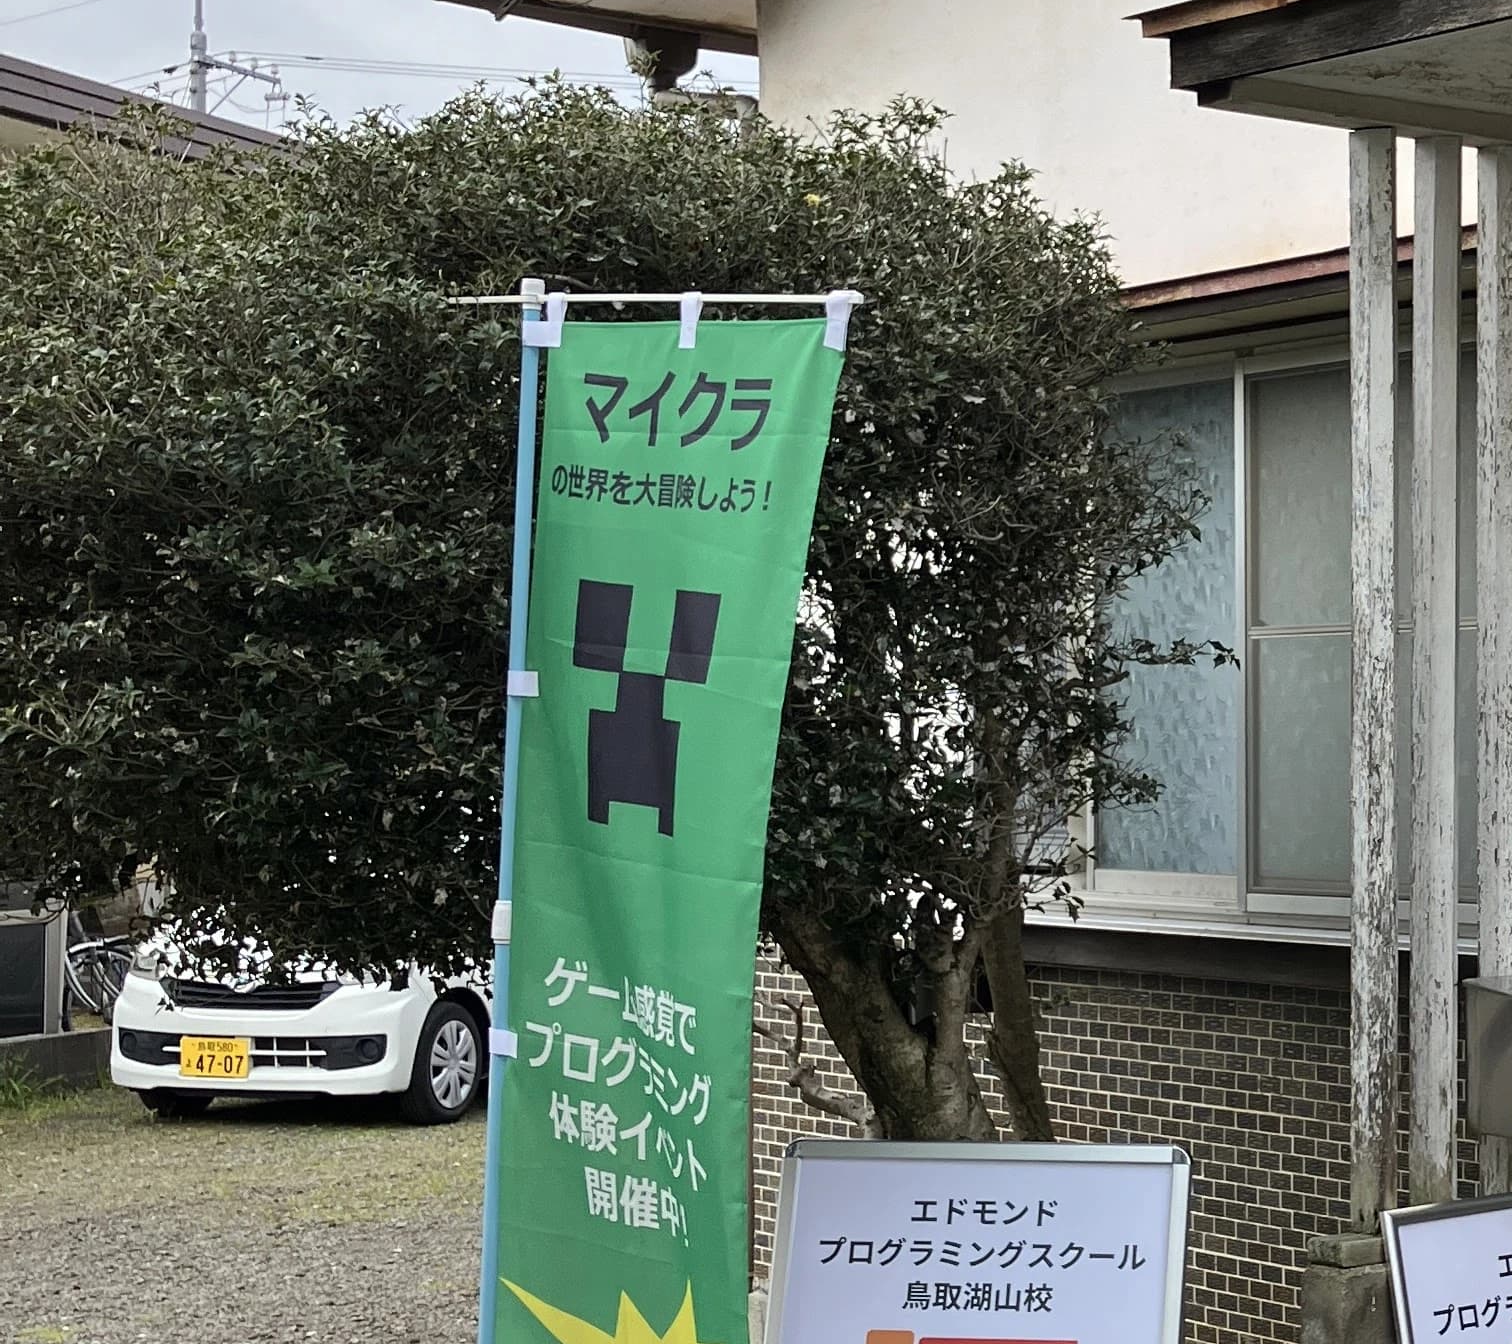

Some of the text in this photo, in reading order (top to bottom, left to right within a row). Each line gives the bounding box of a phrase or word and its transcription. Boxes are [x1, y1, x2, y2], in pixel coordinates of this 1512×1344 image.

[583, 371, 773, 451] マイクラ
[551, 464, 771, 513] の世界を大冒険しよう！
[544, 956, 697, 1055] ゲーム感覚で
[195, 1054, 244, 1074] 47-07
[525, 1021, 712, 1126] プログラミング
[548, 1090, 708, 1193] 体験イベント
[584, 1165, 690, 1247] 開催中！
[911, 1197, 1058, 1227] エドモンド
[818, 1237, 1146, 1271] プログラミングスクール
[902, 1280, 1054, 1313] 鳥取湖山校
